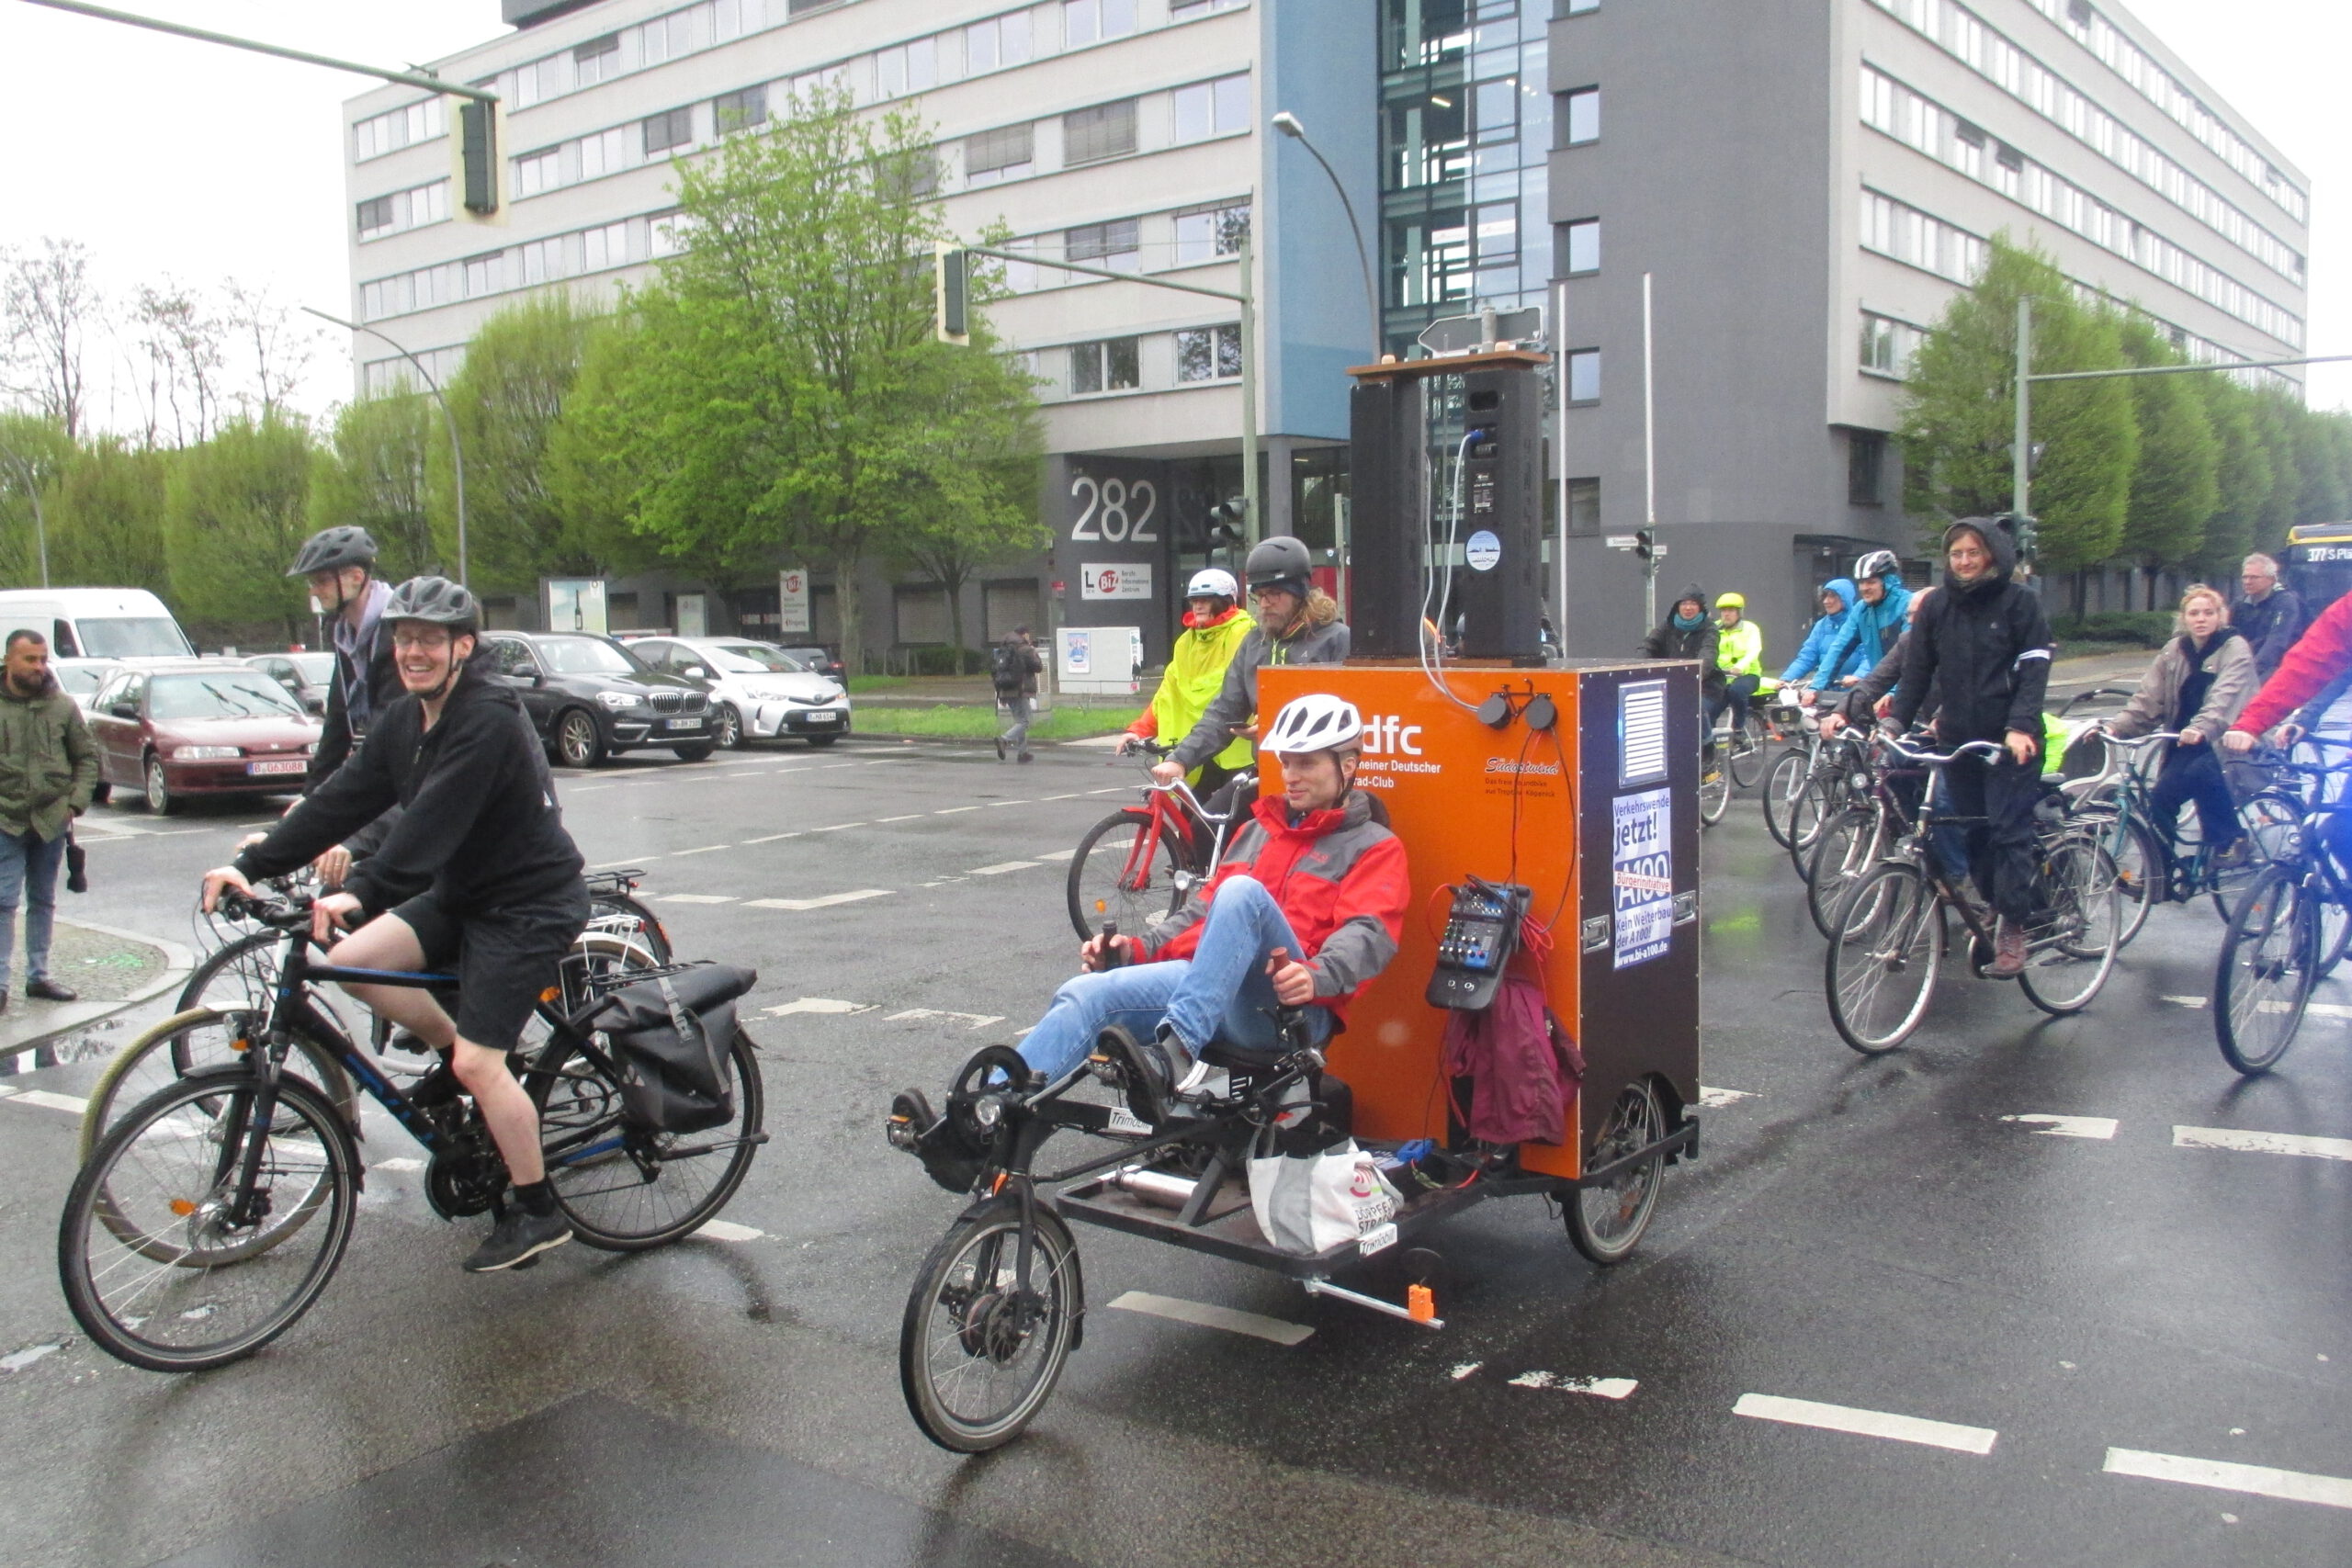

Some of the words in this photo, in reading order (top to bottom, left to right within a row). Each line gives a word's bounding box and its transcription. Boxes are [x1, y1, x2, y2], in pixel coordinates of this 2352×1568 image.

[1071, 476, 1158, 543] 282
[2327, 548, 2335, 560] S
[1101, 571, 1118, 590] BiZ
[254, 763, 261, 773] B
[1391, 760, 1442, 773] Deutscher
[1614, 795, 1669, 818] Verkehrswende
[1614, 811, 1657, 856] jetzt!
[1617, 916, 1633, 932] Kein
[1634, 908, 1671, 928] Weiterbau
[1617, 933, 1630, 949] der
